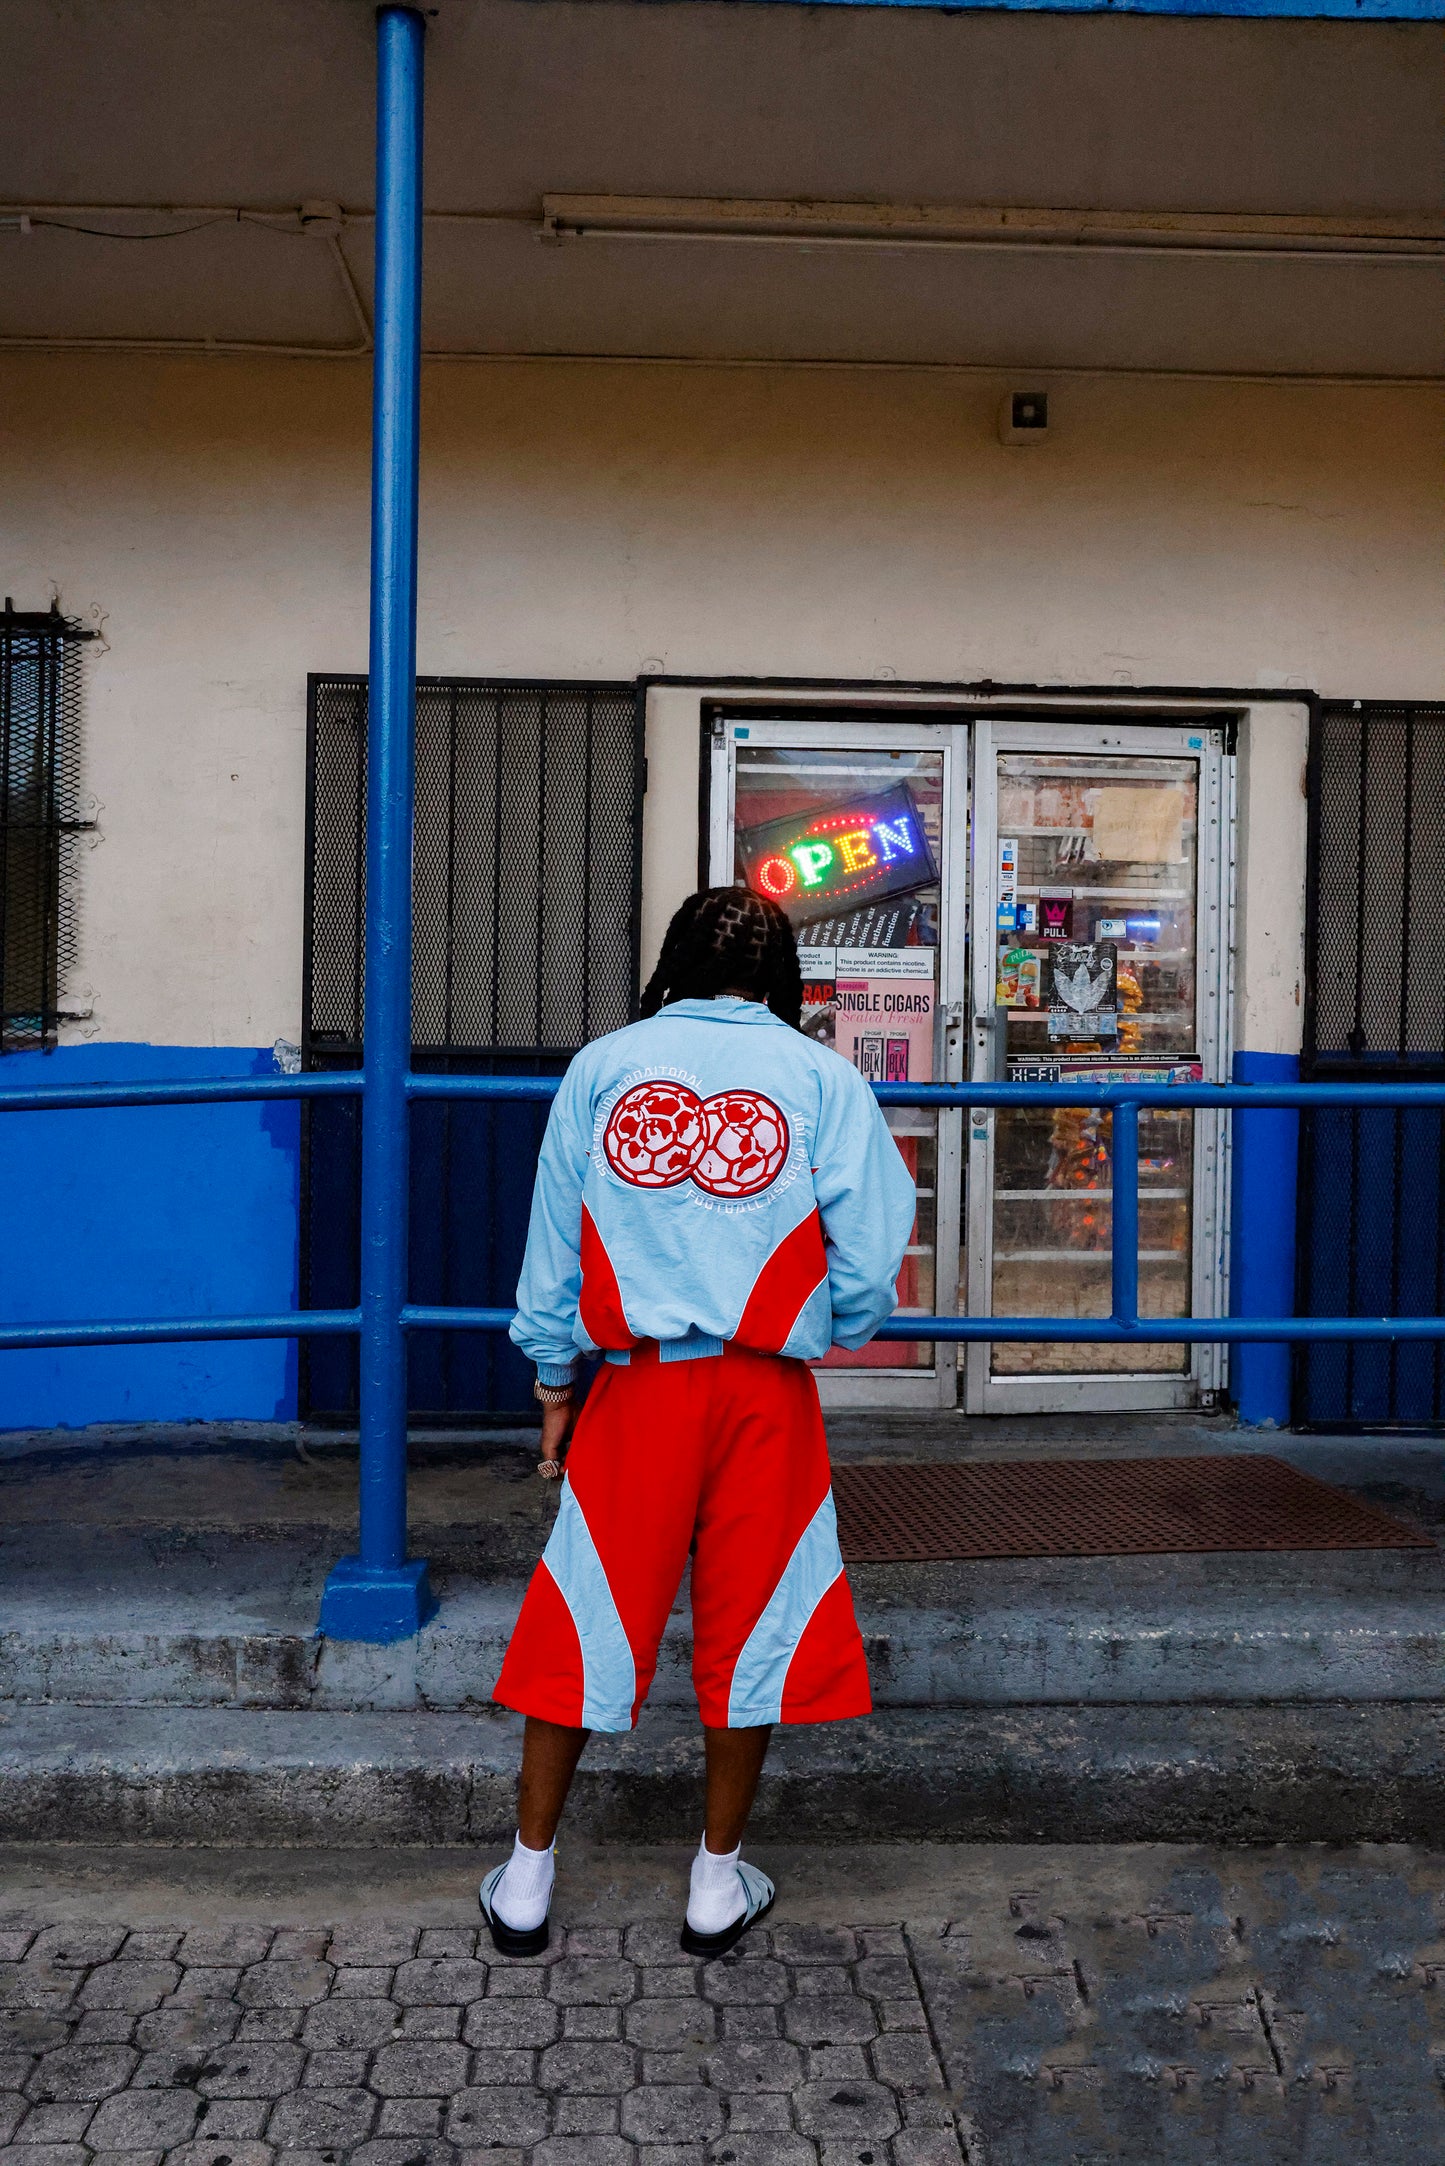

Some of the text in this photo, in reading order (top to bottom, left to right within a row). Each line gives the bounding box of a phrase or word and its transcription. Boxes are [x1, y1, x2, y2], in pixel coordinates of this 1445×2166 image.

[759, 817, 914, 894] OPEN
[851, 912, 862, 936] acute
[867, 907, 876, 921] ear
[833, 922, 846, 945] death
[871, 914, 887, 946] asthma,
[882, 910, 900, 947] function.
[1043, 928, 1067, 938] PULL
[836, 993, 930, 1012] SINGLE CIGARS
[841, 1010, 923, 1024] Sealed Fresh
[864, 1053, 880, 1073] BLK
[889, 1054, 905, 1074] BLK
[1012, 1067, 1053, 1082] HI-FI
[685, 1112, 806, 1214] FOOTBALL ASSOCIATION
